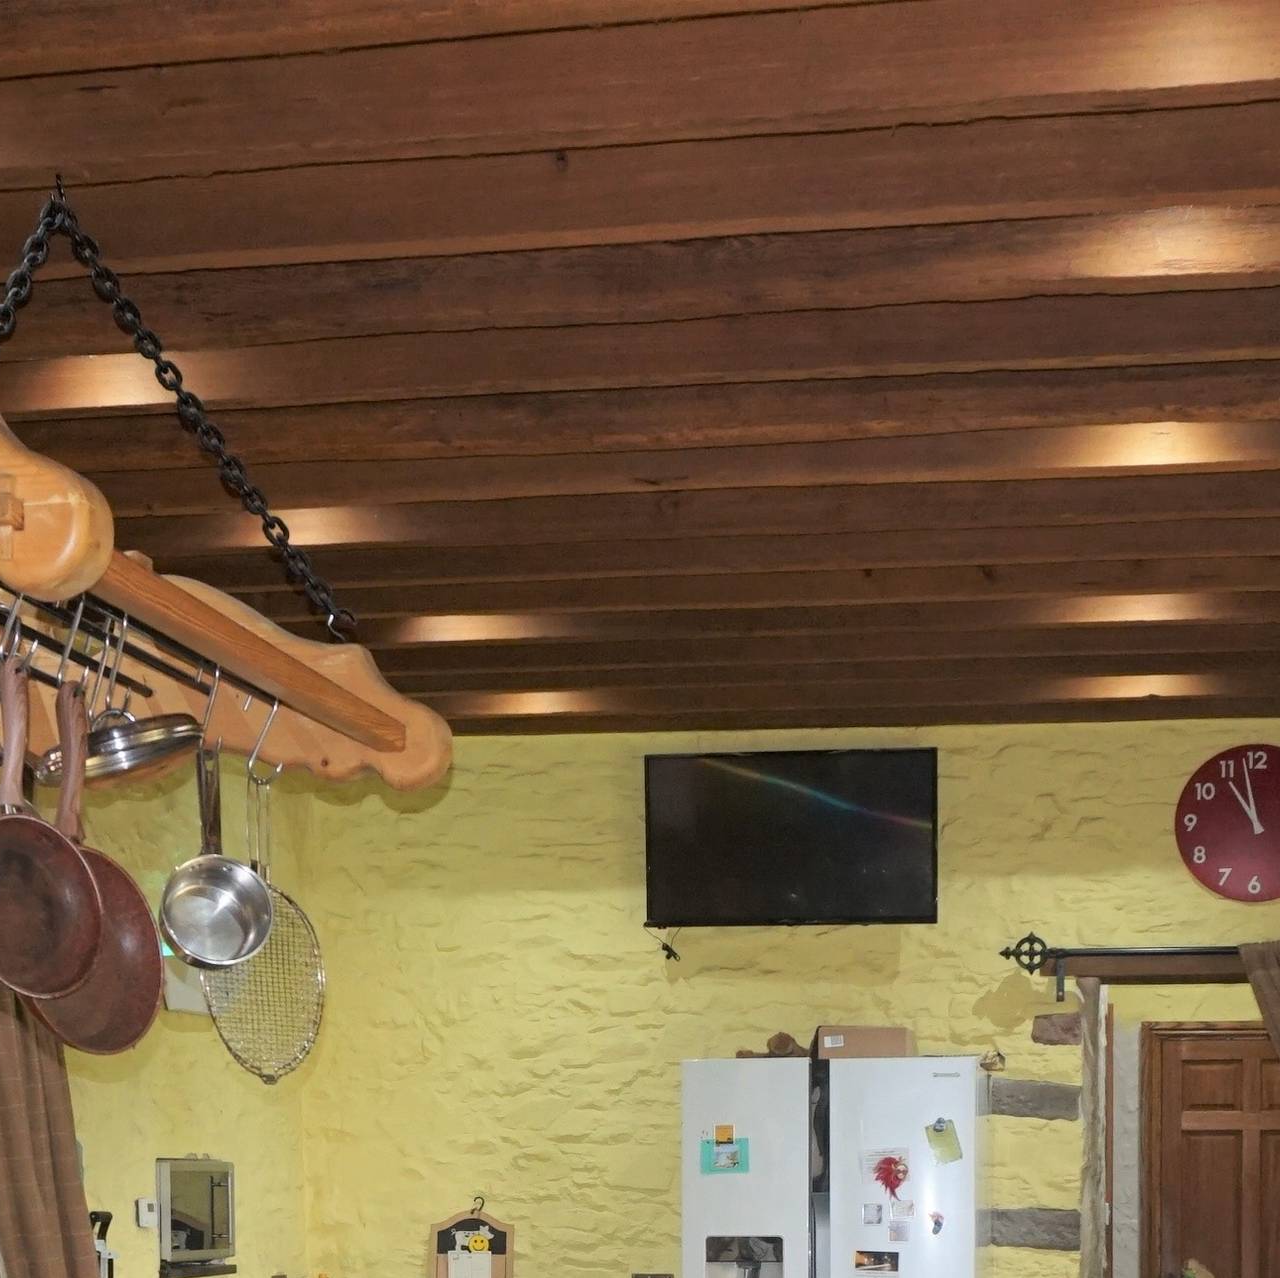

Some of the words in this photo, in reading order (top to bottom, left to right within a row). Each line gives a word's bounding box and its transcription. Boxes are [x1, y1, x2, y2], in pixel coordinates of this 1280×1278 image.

[1220, 760, 1235, 778] 11
[1247, 751, 1268, 769] 12
[1195, 782, 1216, 801] 10
[1183, 813, 1197, 832] 9
[1193, 845, 1206, 864] 8
[1218, 867, 1233, 887] 7
[1247, 875, 1261, 894] 6
